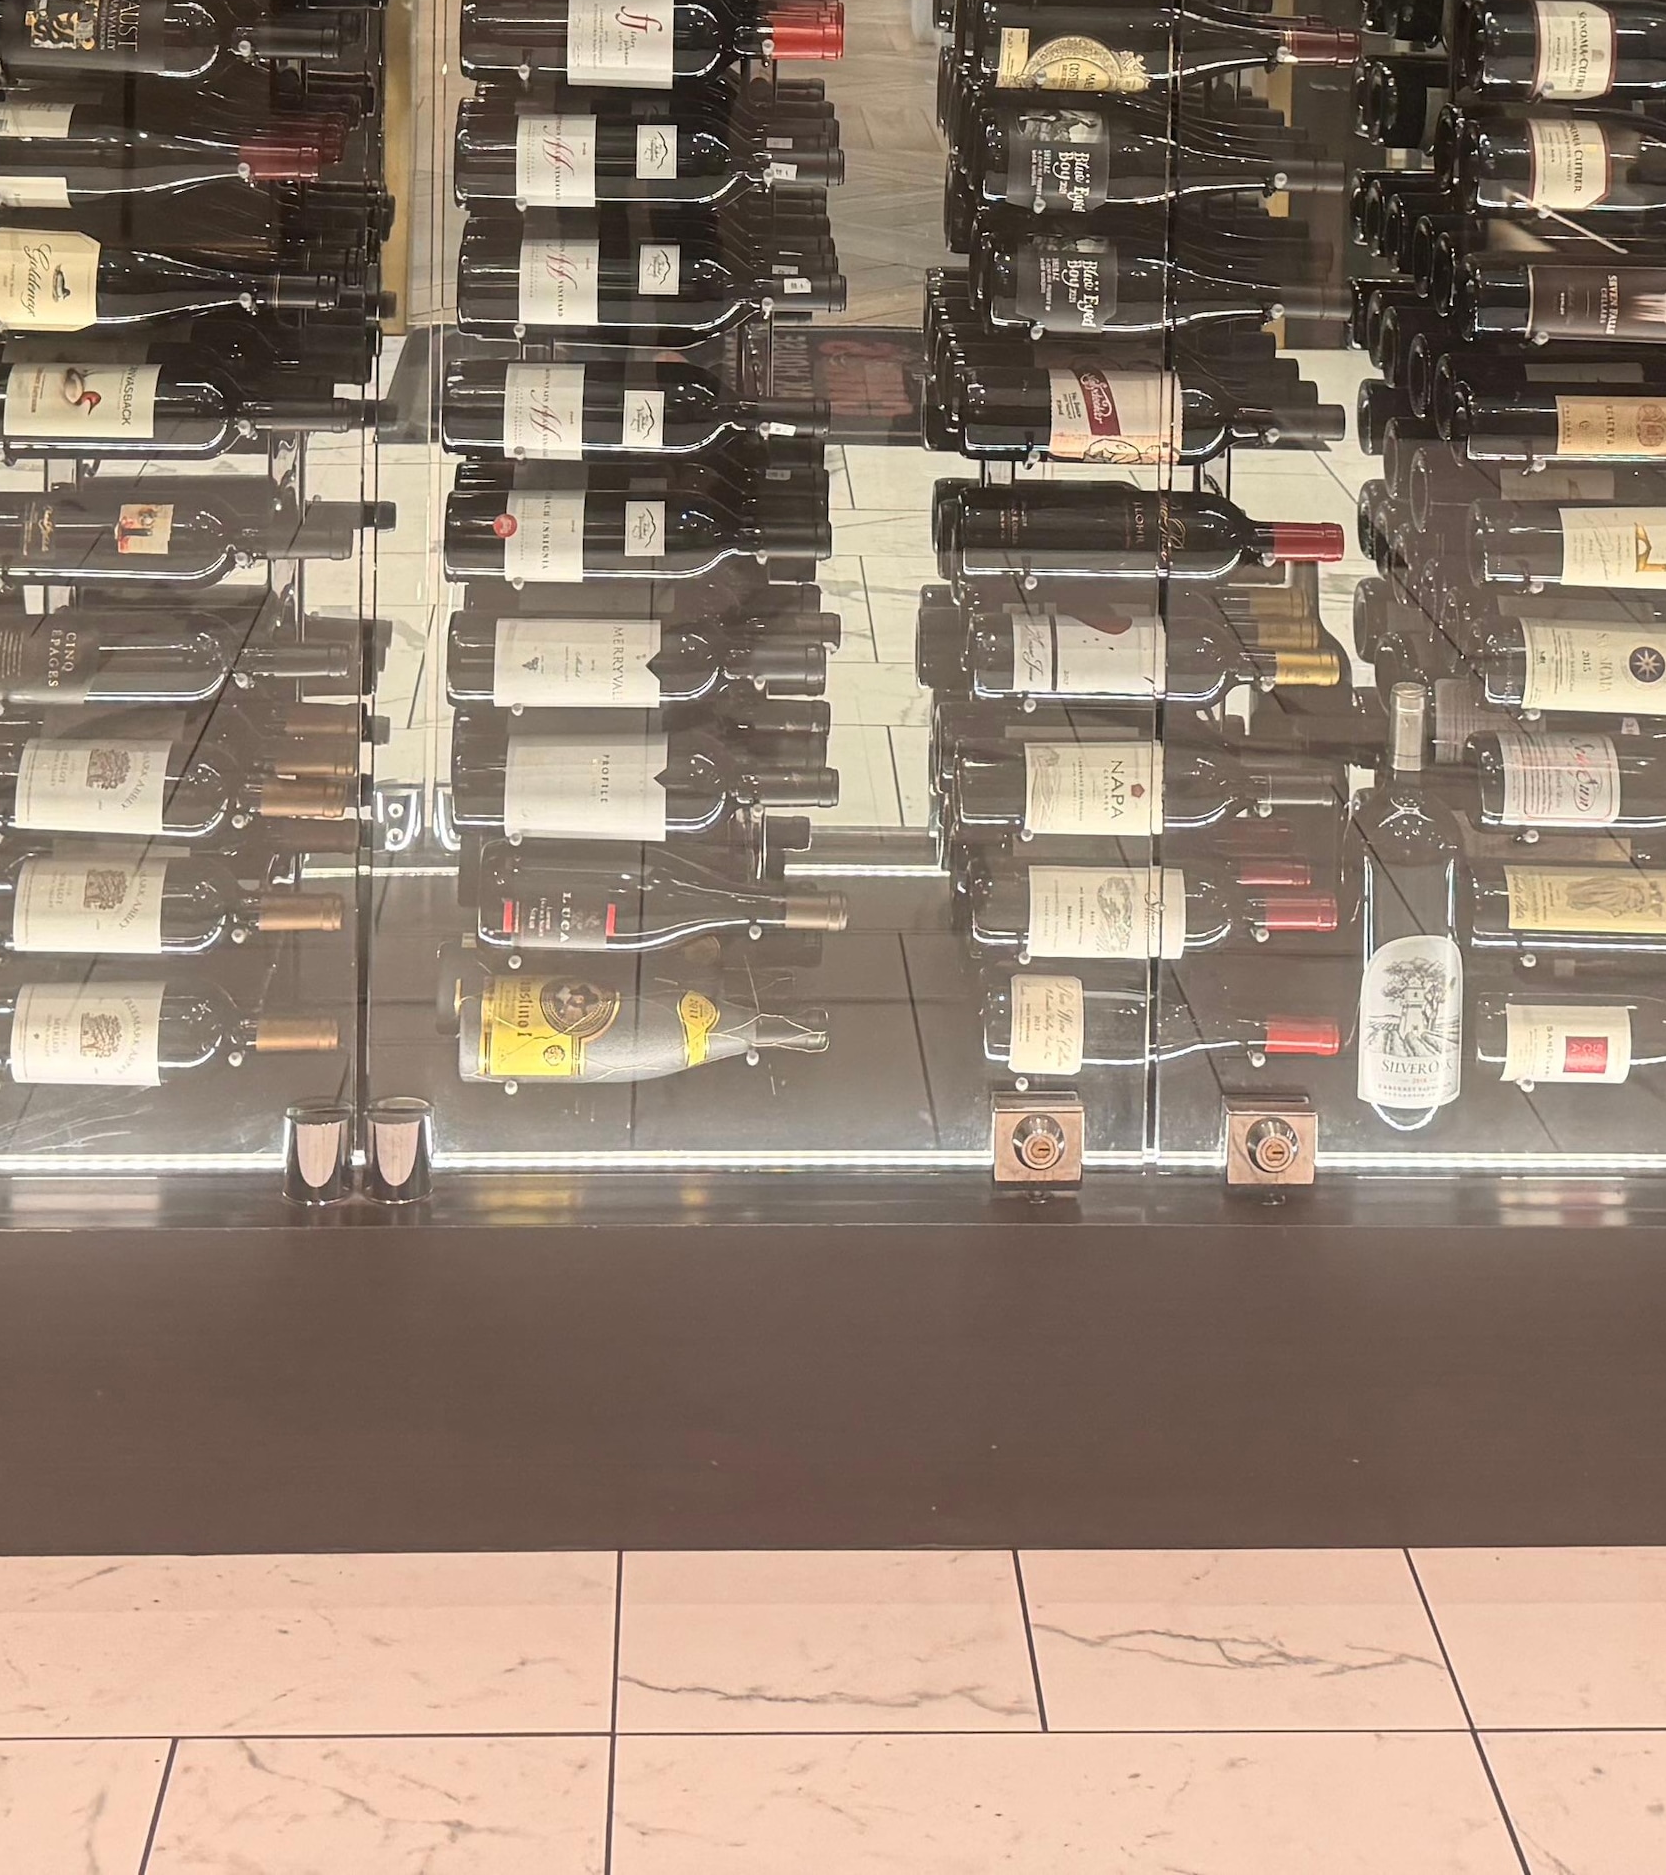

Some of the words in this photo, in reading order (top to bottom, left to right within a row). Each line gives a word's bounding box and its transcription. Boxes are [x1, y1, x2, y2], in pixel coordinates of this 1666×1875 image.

[107, 19, 117, 51] VALLEY
[1052, 151, 1076, 179] Boy
[23, 245, 49, 317] Goldeneye
[1063, 259, 1083, 288] Boy
[1607, 275, 1619, 305] SEVEN
[1077, 294, 1100, 327] Eyed
[1599, 287, 1608, 324] CELLARS
[1605, 307, 1617, 335] FALLS
[541, 521, 551, 570] INSIGNIA
[47, 629, 64, 687] ÉPAGES
[62, 631, 77, 672] CINQ
[1583, 649, 1592, 672] 2015
[599, 753, 611, 804] PROFILE
[1108, 759, 1125, 819] NAPA
[559, 892, 573, 943] LUCA
[1382, 1059, 1427, 1074] SILVER
